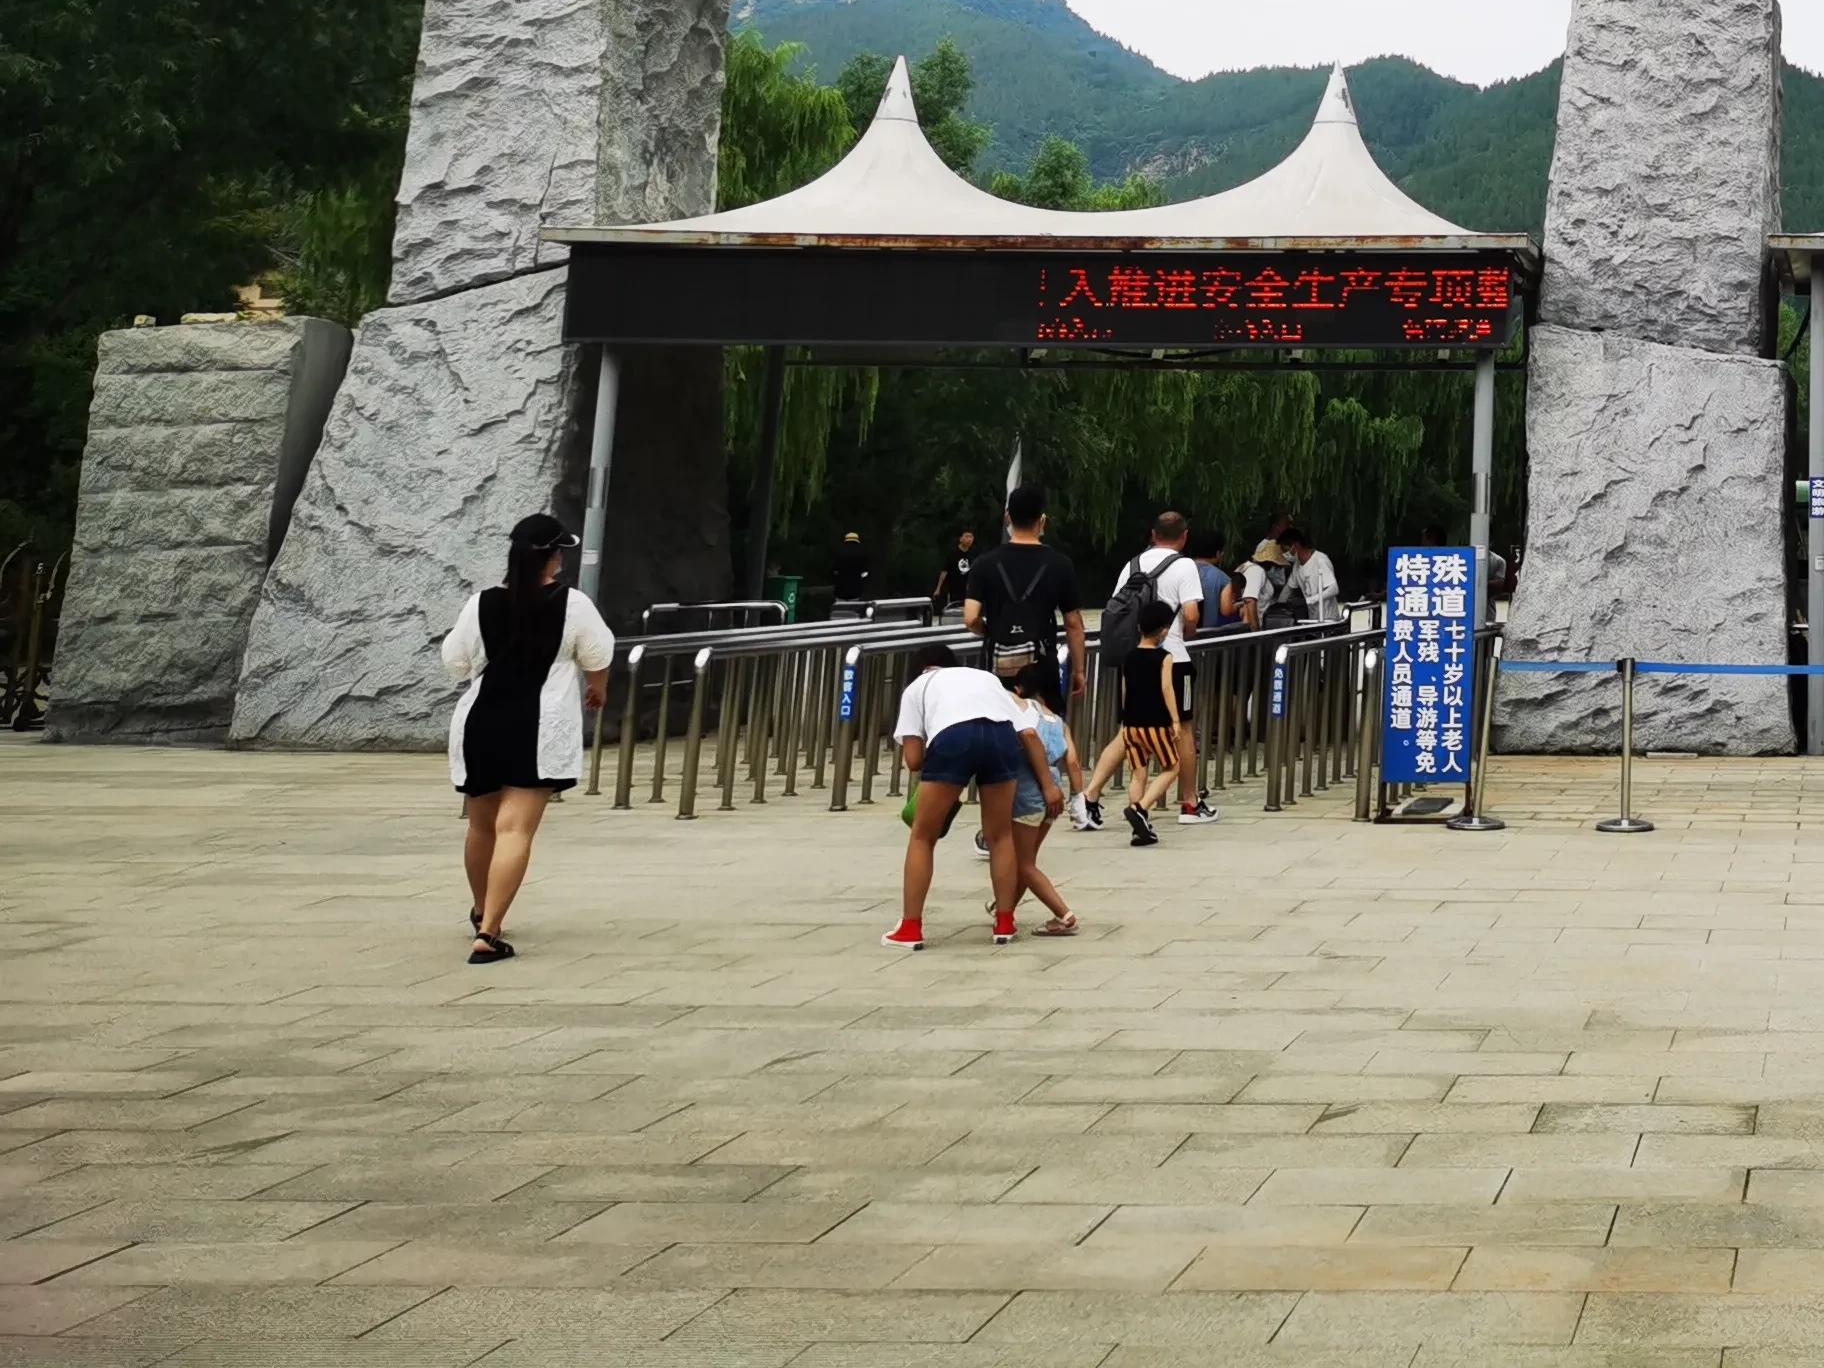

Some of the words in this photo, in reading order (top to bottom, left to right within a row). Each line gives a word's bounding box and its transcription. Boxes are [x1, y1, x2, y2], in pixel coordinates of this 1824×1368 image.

[1394, 586, 1467, 618] 通道
[1395, 553, 1468, 585] 特殊
[1415, 620, 1440, 774] 军残、导游等免
[1441, 620, 1466, 774] 七十岁以上老人
